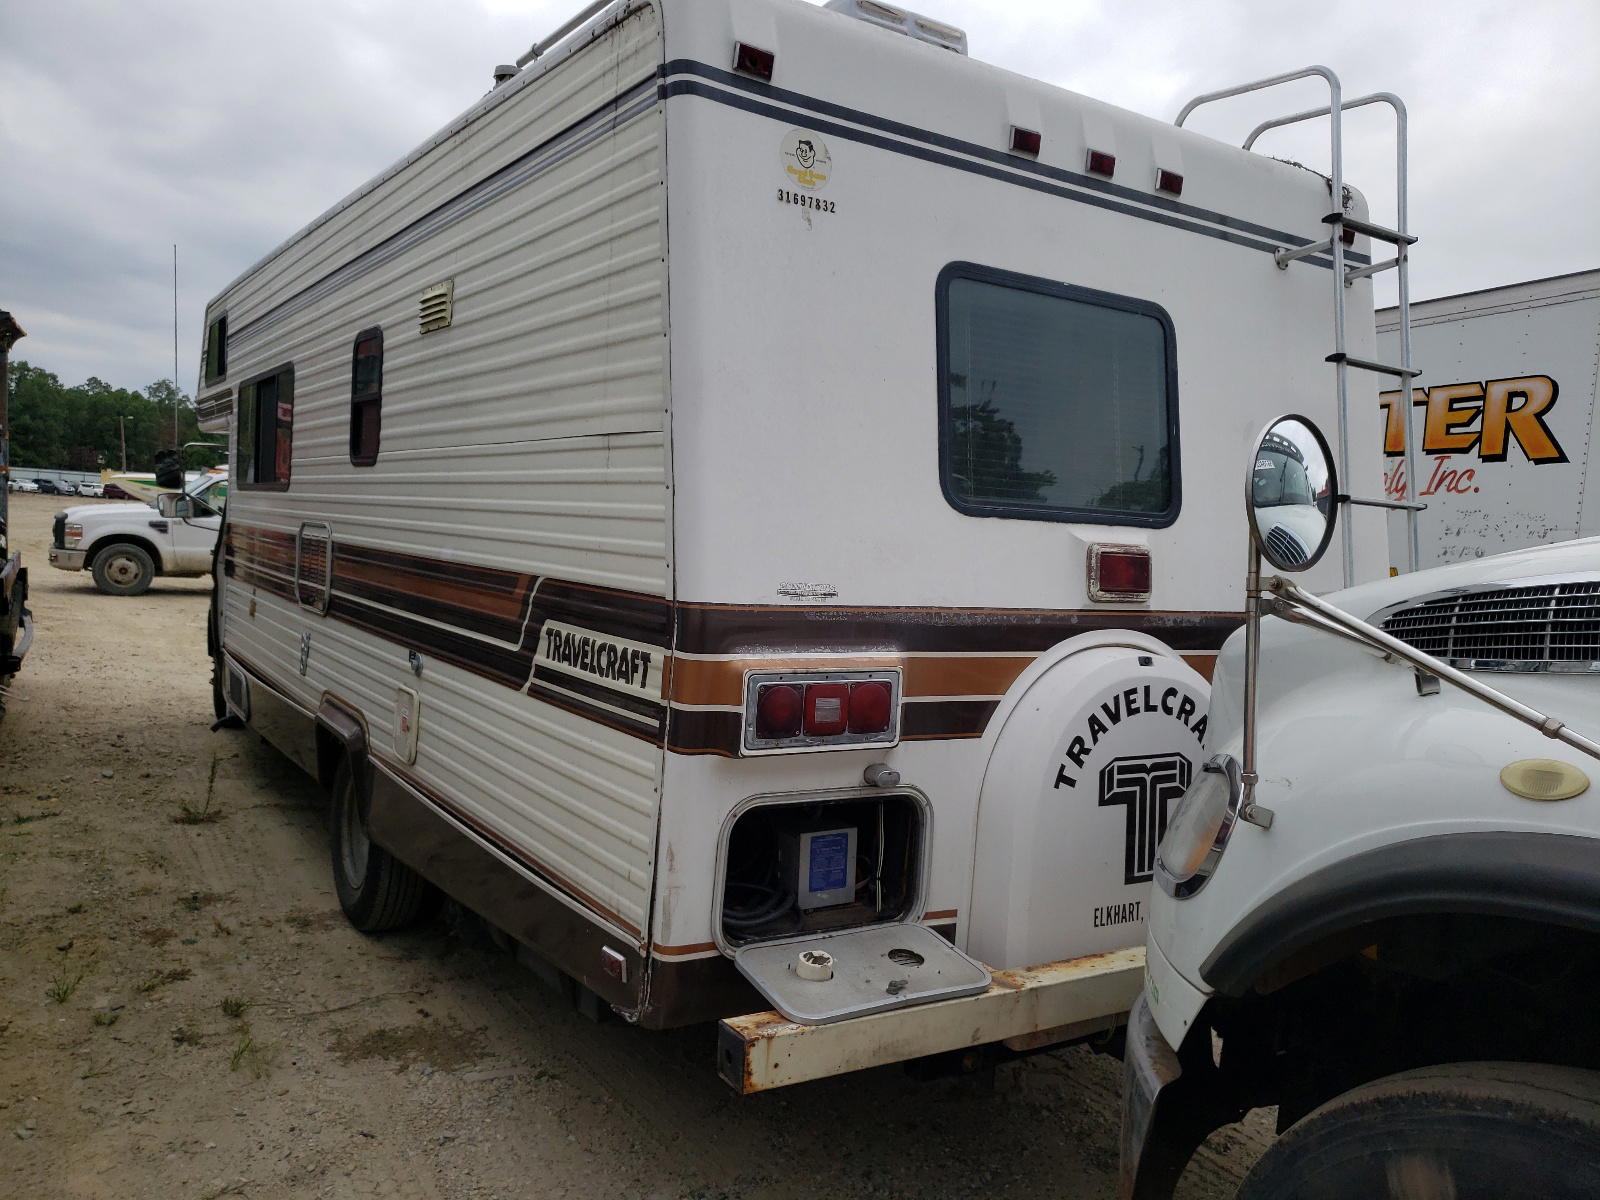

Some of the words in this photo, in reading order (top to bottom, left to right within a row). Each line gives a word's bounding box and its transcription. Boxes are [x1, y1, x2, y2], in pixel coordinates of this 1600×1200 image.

[777, 188, 836, 213] 31697832
[1419, 455, 1480, 496] Inc.
[545, 627, 652, 690] TRAVELCRAFT
[1053, 684, 1208, 790] TRAVELCRA
[1093, 901, 1144, 928] ELKHART,
